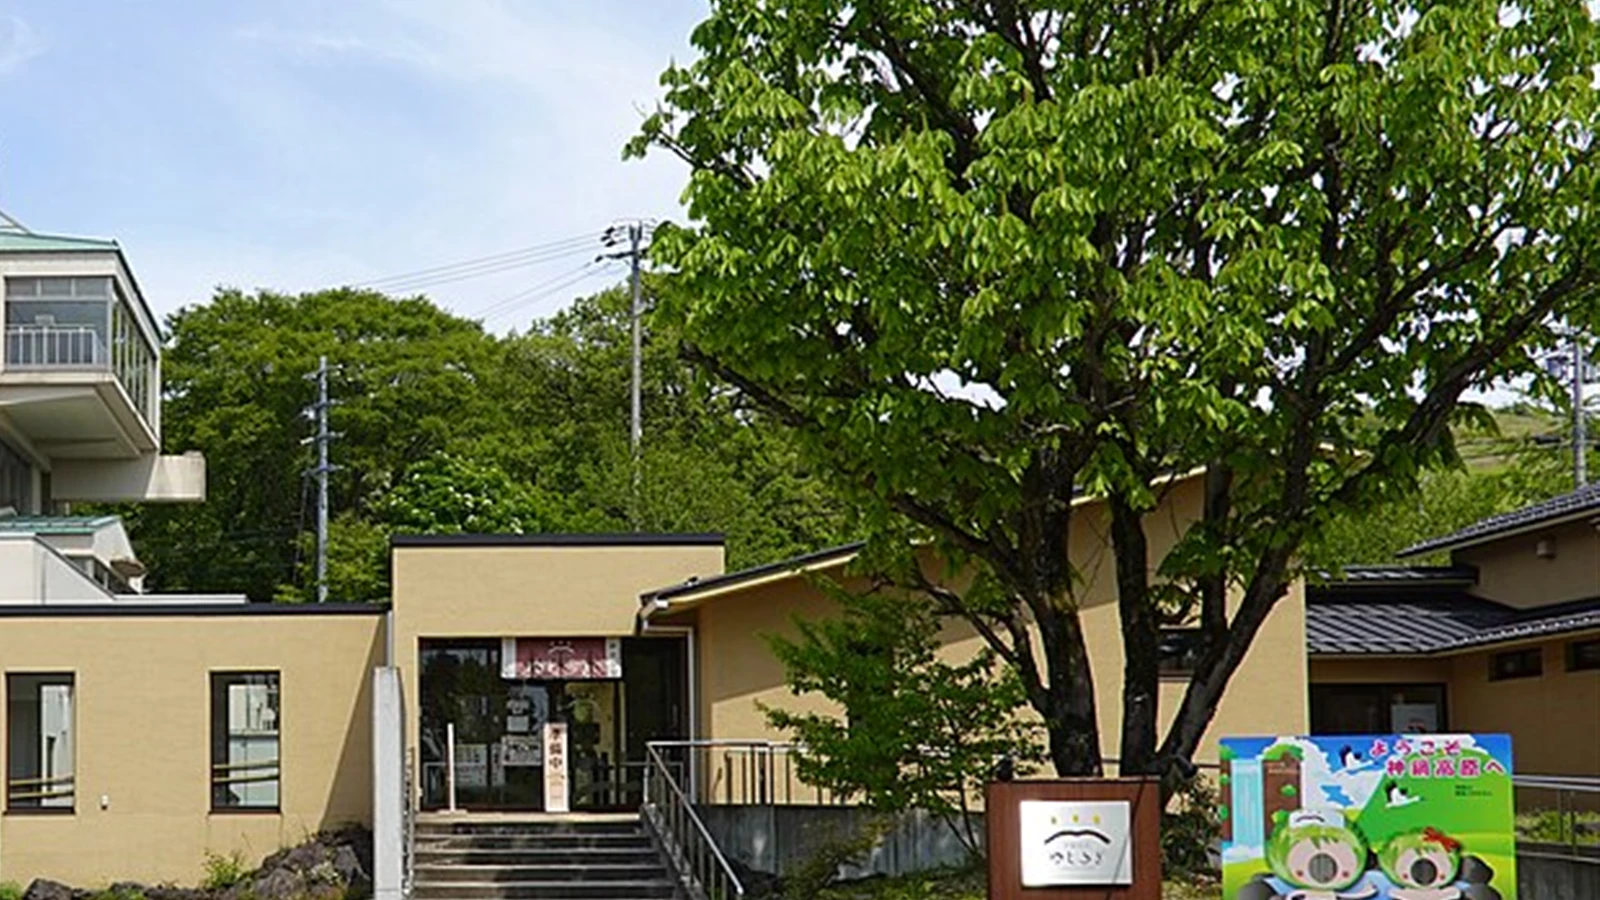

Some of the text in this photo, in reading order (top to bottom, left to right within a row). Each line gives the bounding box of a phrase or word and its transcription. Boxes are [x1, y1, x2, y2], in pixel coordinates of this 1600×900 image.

[1370, 739, 1462, 758] ようこそ
[1385, 759, 1507, 778] 神鍋高原へ
